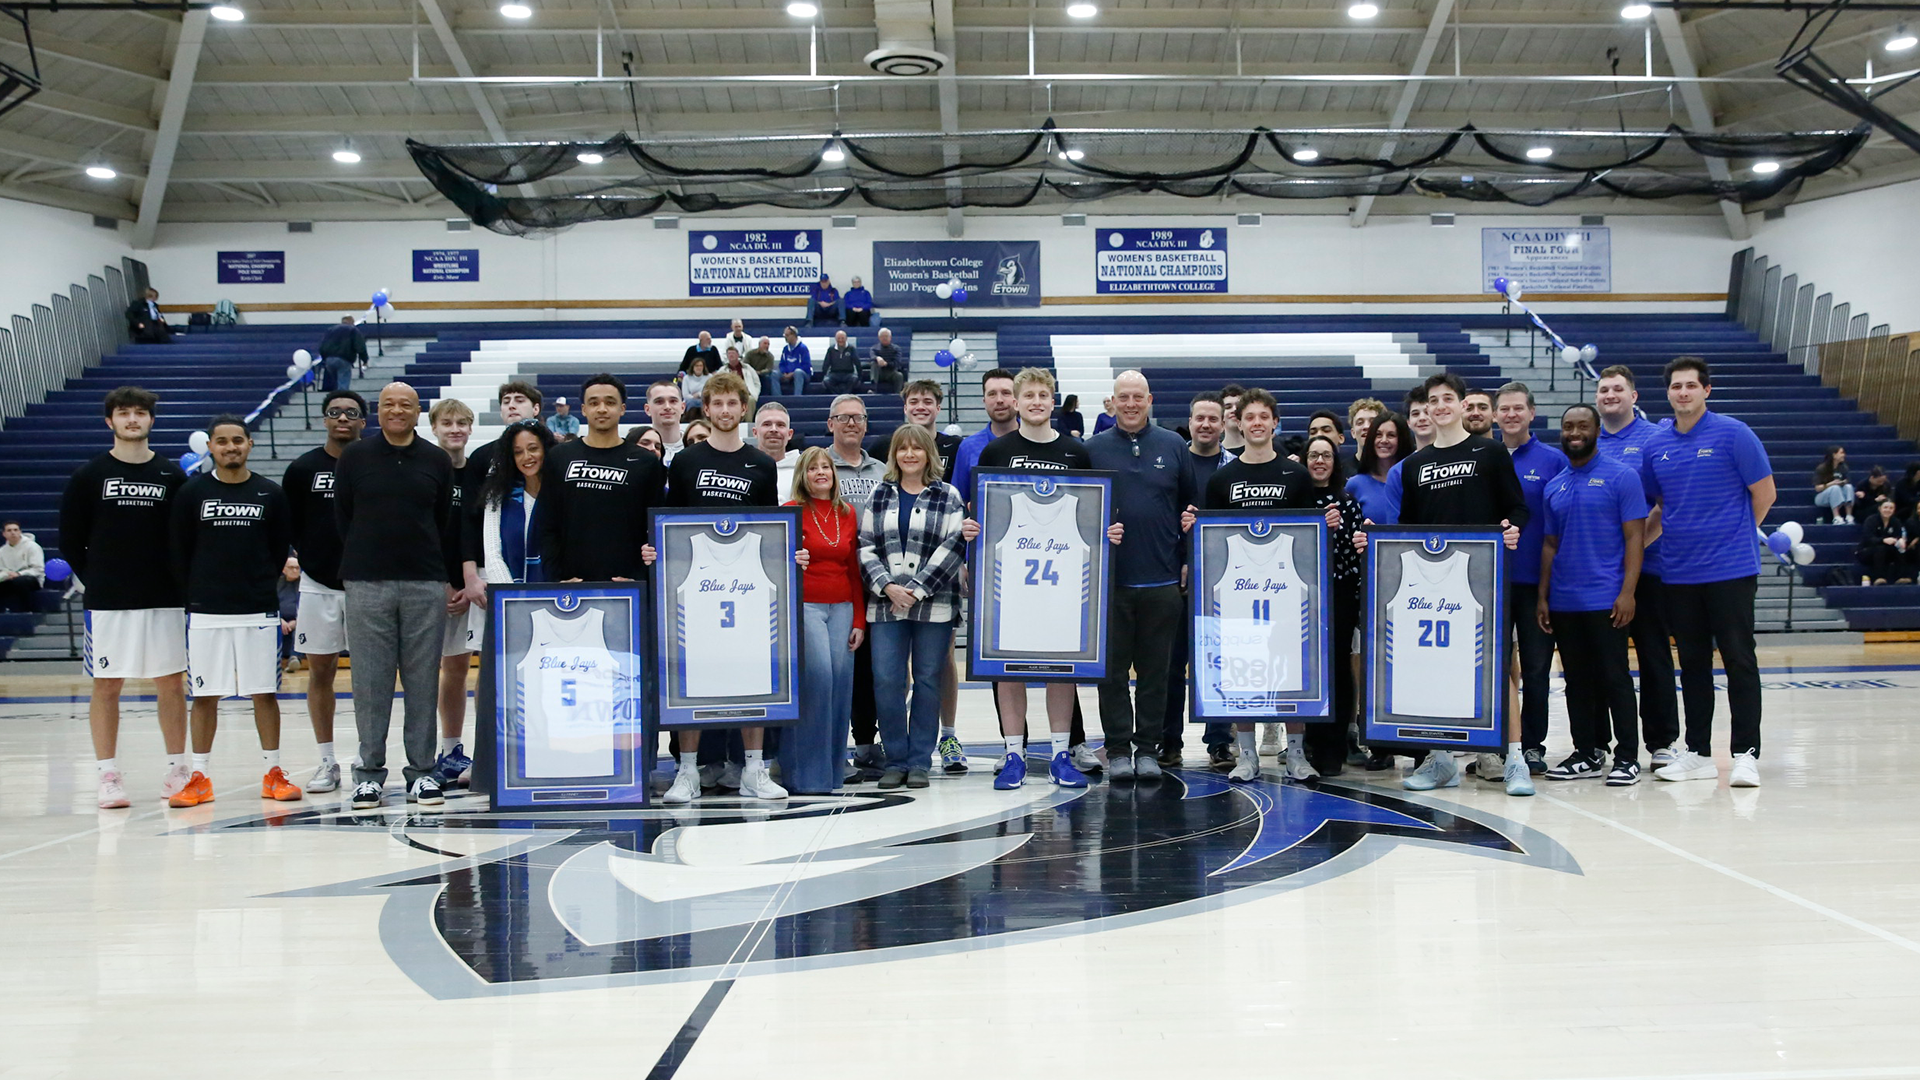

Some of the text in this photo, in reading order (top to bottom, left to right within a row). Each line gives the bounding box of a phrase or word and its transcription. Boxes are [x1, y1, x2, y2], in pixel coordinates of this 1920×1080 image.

[744, 233, 767, 242] 1982
[1151, 231, 1173, 240] 1989
[1501, 232, 1541, 242] NCAA
[755, 242, 771, 250] DIV.
[772, 242, 782, 250] III
[1513, 246, 1547, 254] FINAL
[701, 256, 812, 265] WOMEN'S BASKETBALL
[884, 257, 983, 268] Elizabethtown College
[1108, 254, 1216, 262] WOMEN'S BASKETBALL
[694, 267, 818, 279] NATIONAL CHAMPIONS
[888, 270, 979, 279] Women's Basketball
[1101, 264, 1223, 276] NATIONAL CHAMPIONS
[702, 285, 810, 294] ELIZABETHTOWN COLLEGE
[889, 283, 909, 292] 1100
[911, 283, 937, 293] Progr
[993, 283, 1027, 293] ETOWN
[1109, 283, 1177, 291] ELIZABETHTOWN
[567, 462, 625, 482] ETOWN
[1420, 463, 1473, 483] ETOWN
[576, 481, 613, 491] BASKETBALL
[698, 472, 749, 491] ETOWN
[1430, 479, 1463, 490] BASKETBALL
[105, 480, 163, 498] ETOWN
[1231, 484, 1282, 500] ETOWN
[702, 490, 743, 501] BASKETBALL
[202, 502, 261, 518] ETOWN
[1242, 500, 1273, 508] BASKETBALL
[1016, 537, 1070, 554] Blue Jays
[1024, 558, 1059, 586] 24
[699, 578, 756, 595] Blue Jays
[1234, 578, 1288, 594] Blue Jays
[1407, 596, 1462, 615] Blue Jays
[720, 601, 735, 628] 3
[1252, 599, 1270, 626] 11
[1418, 619, 1450, 648] 20
[539, 656, 598, 672] Blue Jays
[561, 678, 576, 706] 5
